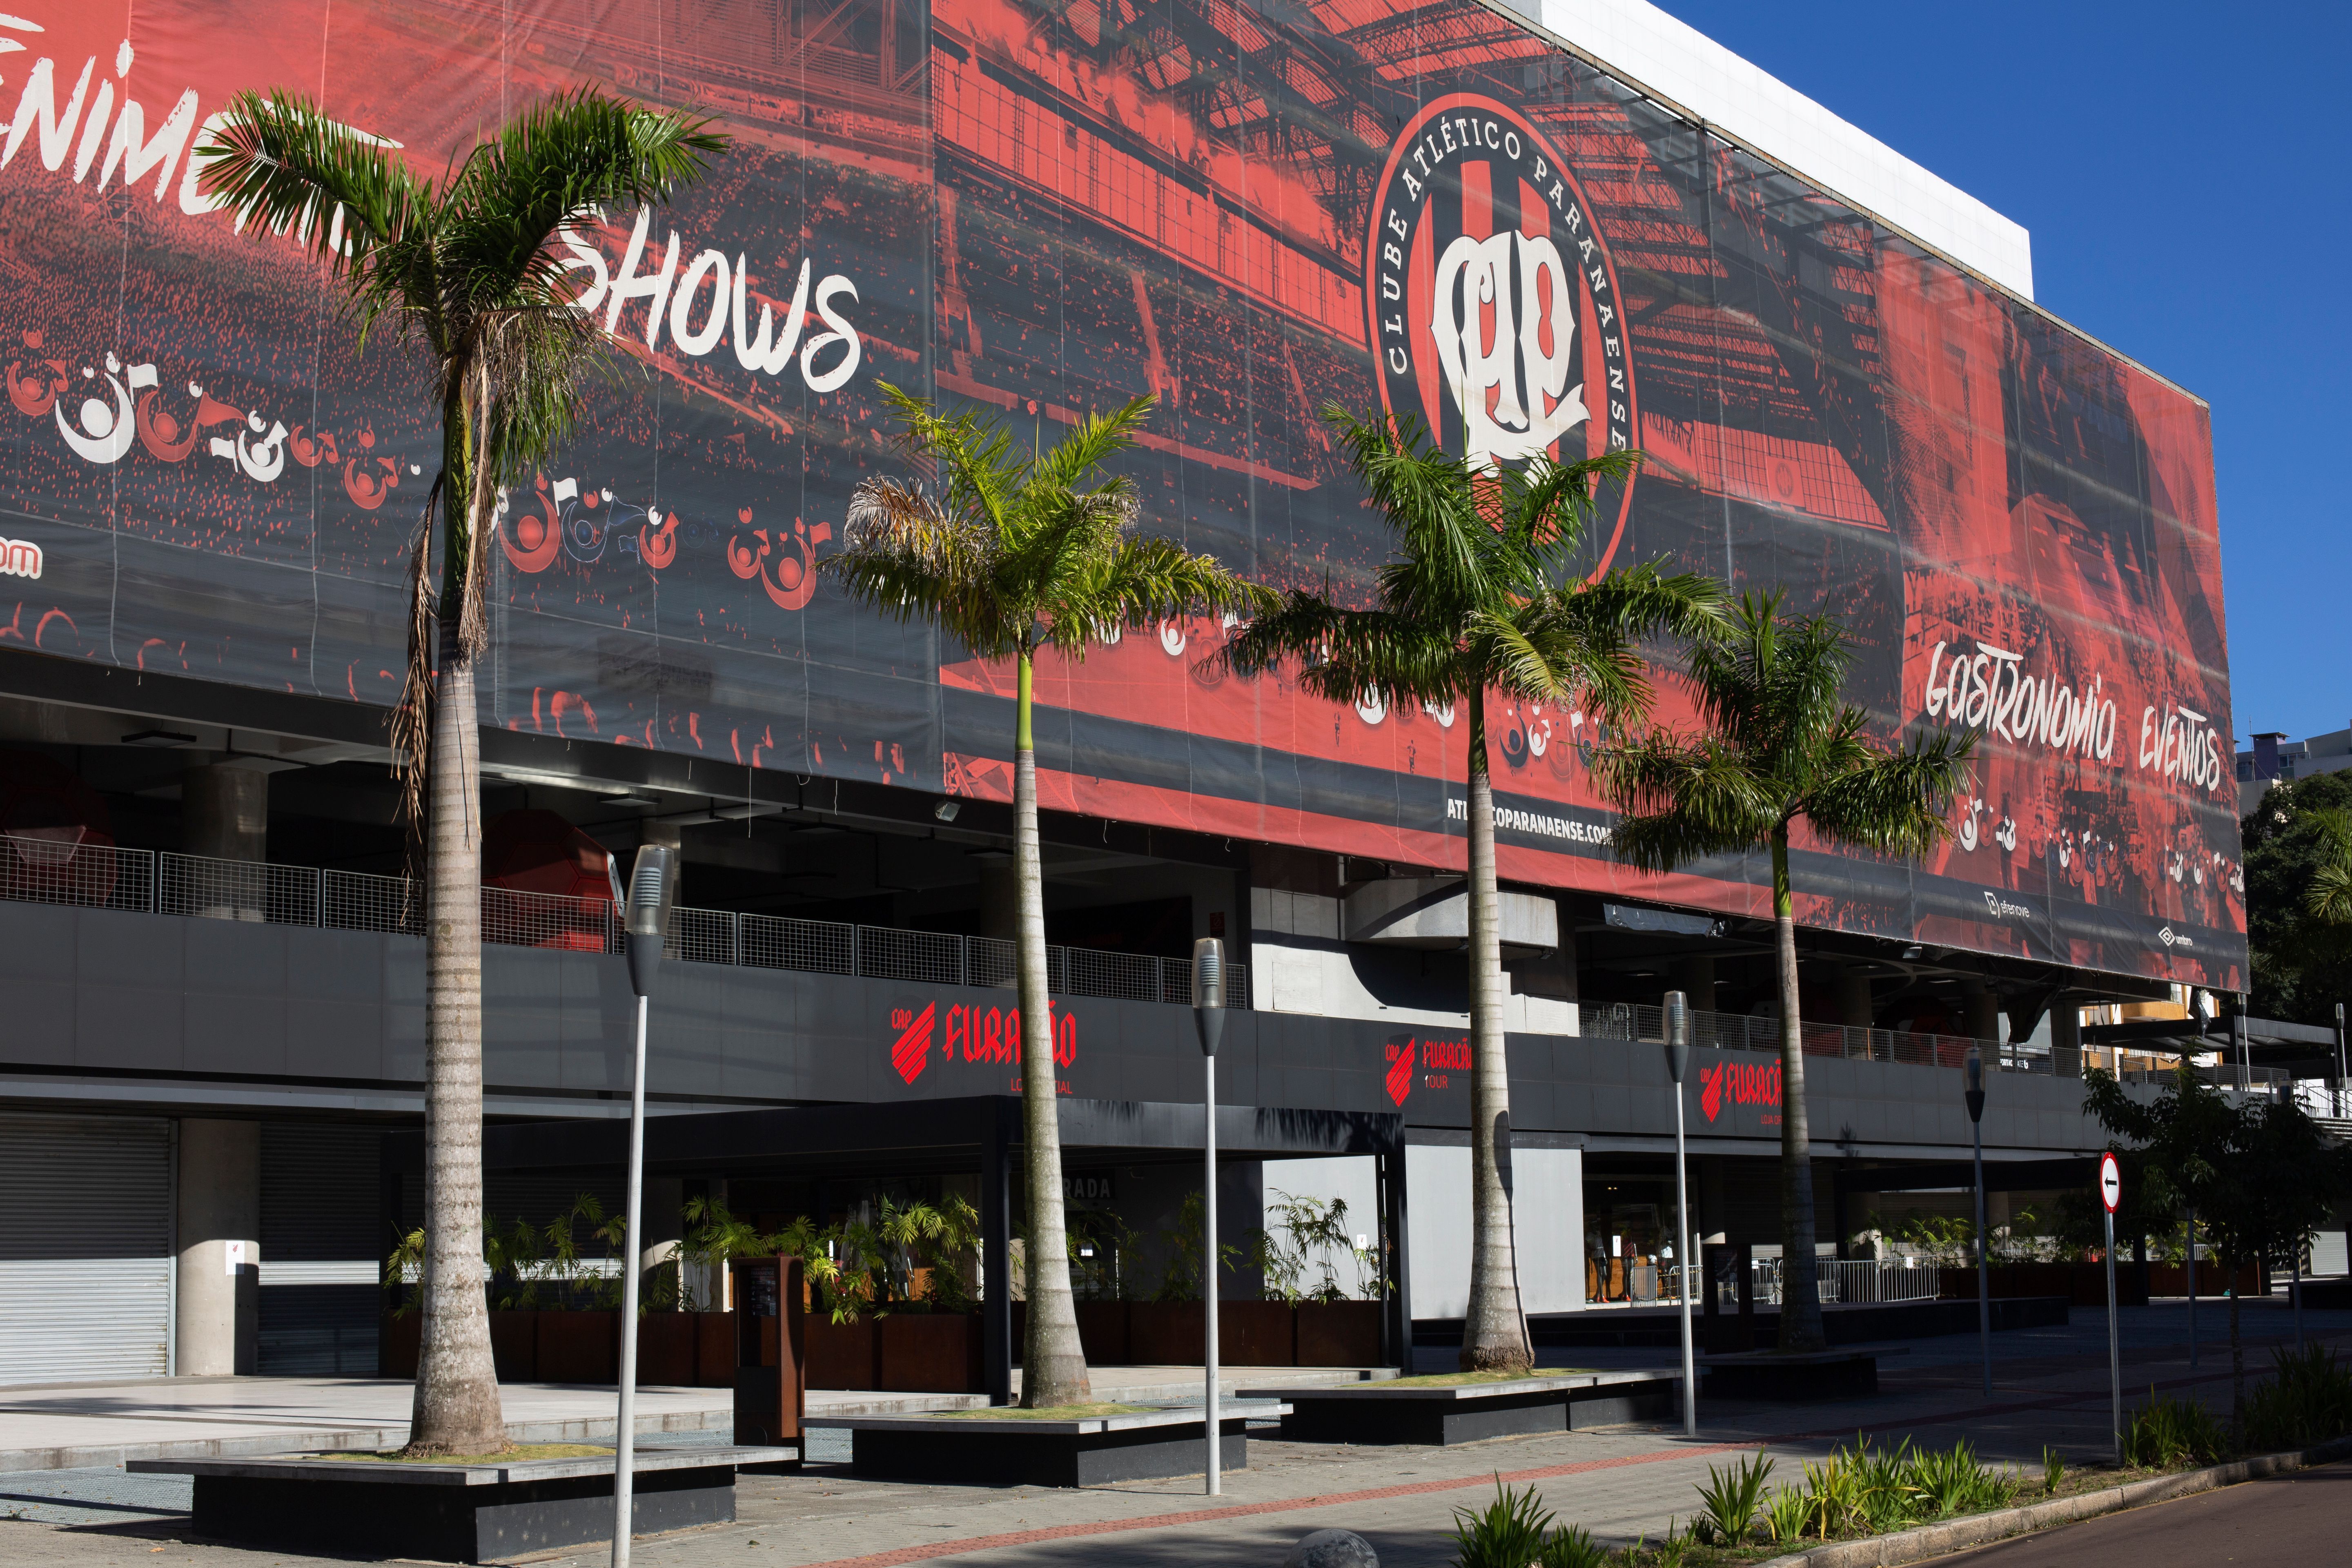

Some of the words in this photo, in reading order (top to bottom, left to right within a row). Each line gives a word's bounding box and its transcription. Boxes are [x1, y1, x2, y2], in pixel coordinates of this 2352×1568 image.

[1383, 208, 1408, 374] CLUBE
[1402, 116, 1521, 202] ATLÉTICO
[1534, 155, 1626, 452] PARANAENSE
[538, 203, 861, 392] SHOWS
[2139, 702, 2220, 791] EVENTOS
[2000, 900, 2030, 918] efenove
[2175, 934, 2193, 947] umbro
[891, 1008, 912, 1030] CAP
[1385, 1044, 1400, 1062] CAP
[1422, 1037, 1472, 1071] FURACÃ
[1699, 1067, 1711, 1083] CAP
[1725, 1058, 1782, 1107] FURACÃ
[1063, 1178, 1111, 1198] RADA
